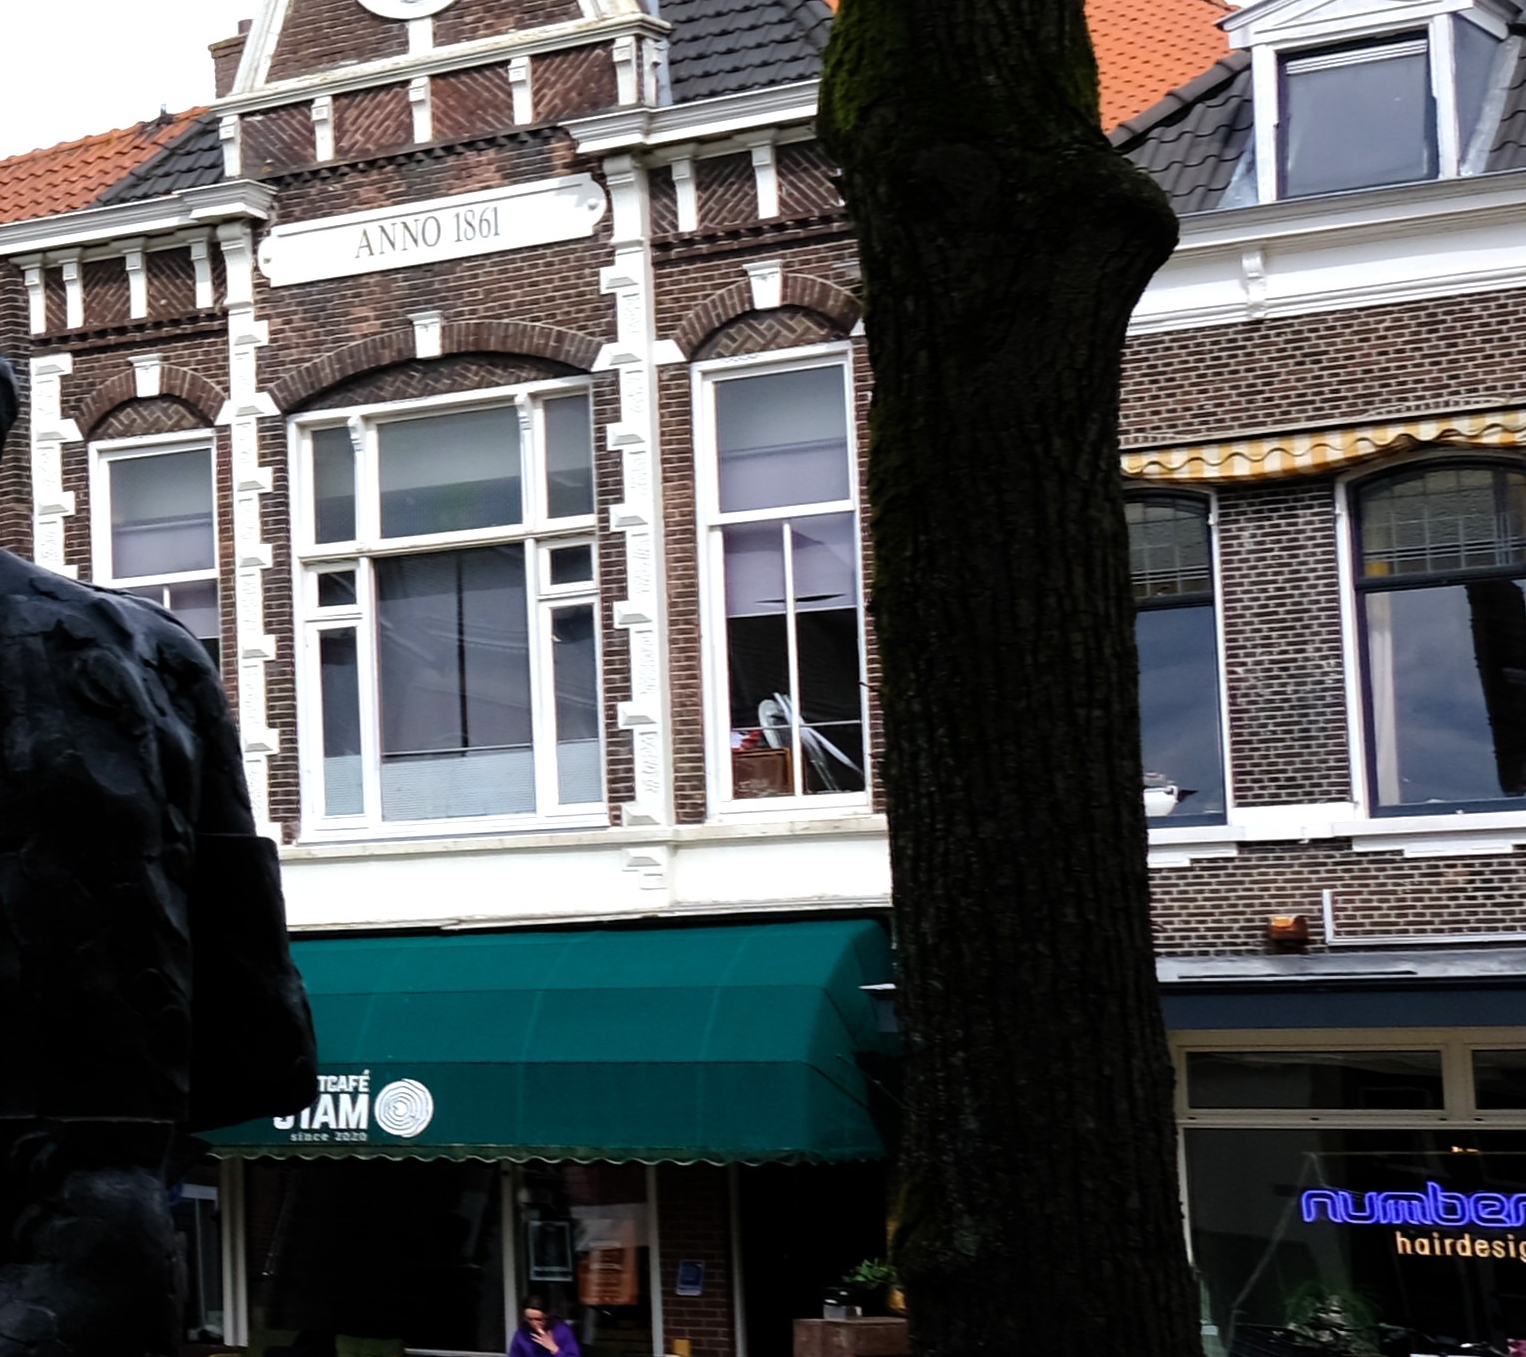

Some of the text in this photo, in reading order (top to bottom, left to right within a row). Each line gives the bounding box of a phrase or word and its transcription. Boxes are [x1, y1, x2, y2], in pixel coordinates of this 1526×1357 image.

[355, 206, 500, 259] ANNO 1861
[316, 1069, 371, 1093] TCAFÉ
[290, 1131, 368, 1142] since 2020
